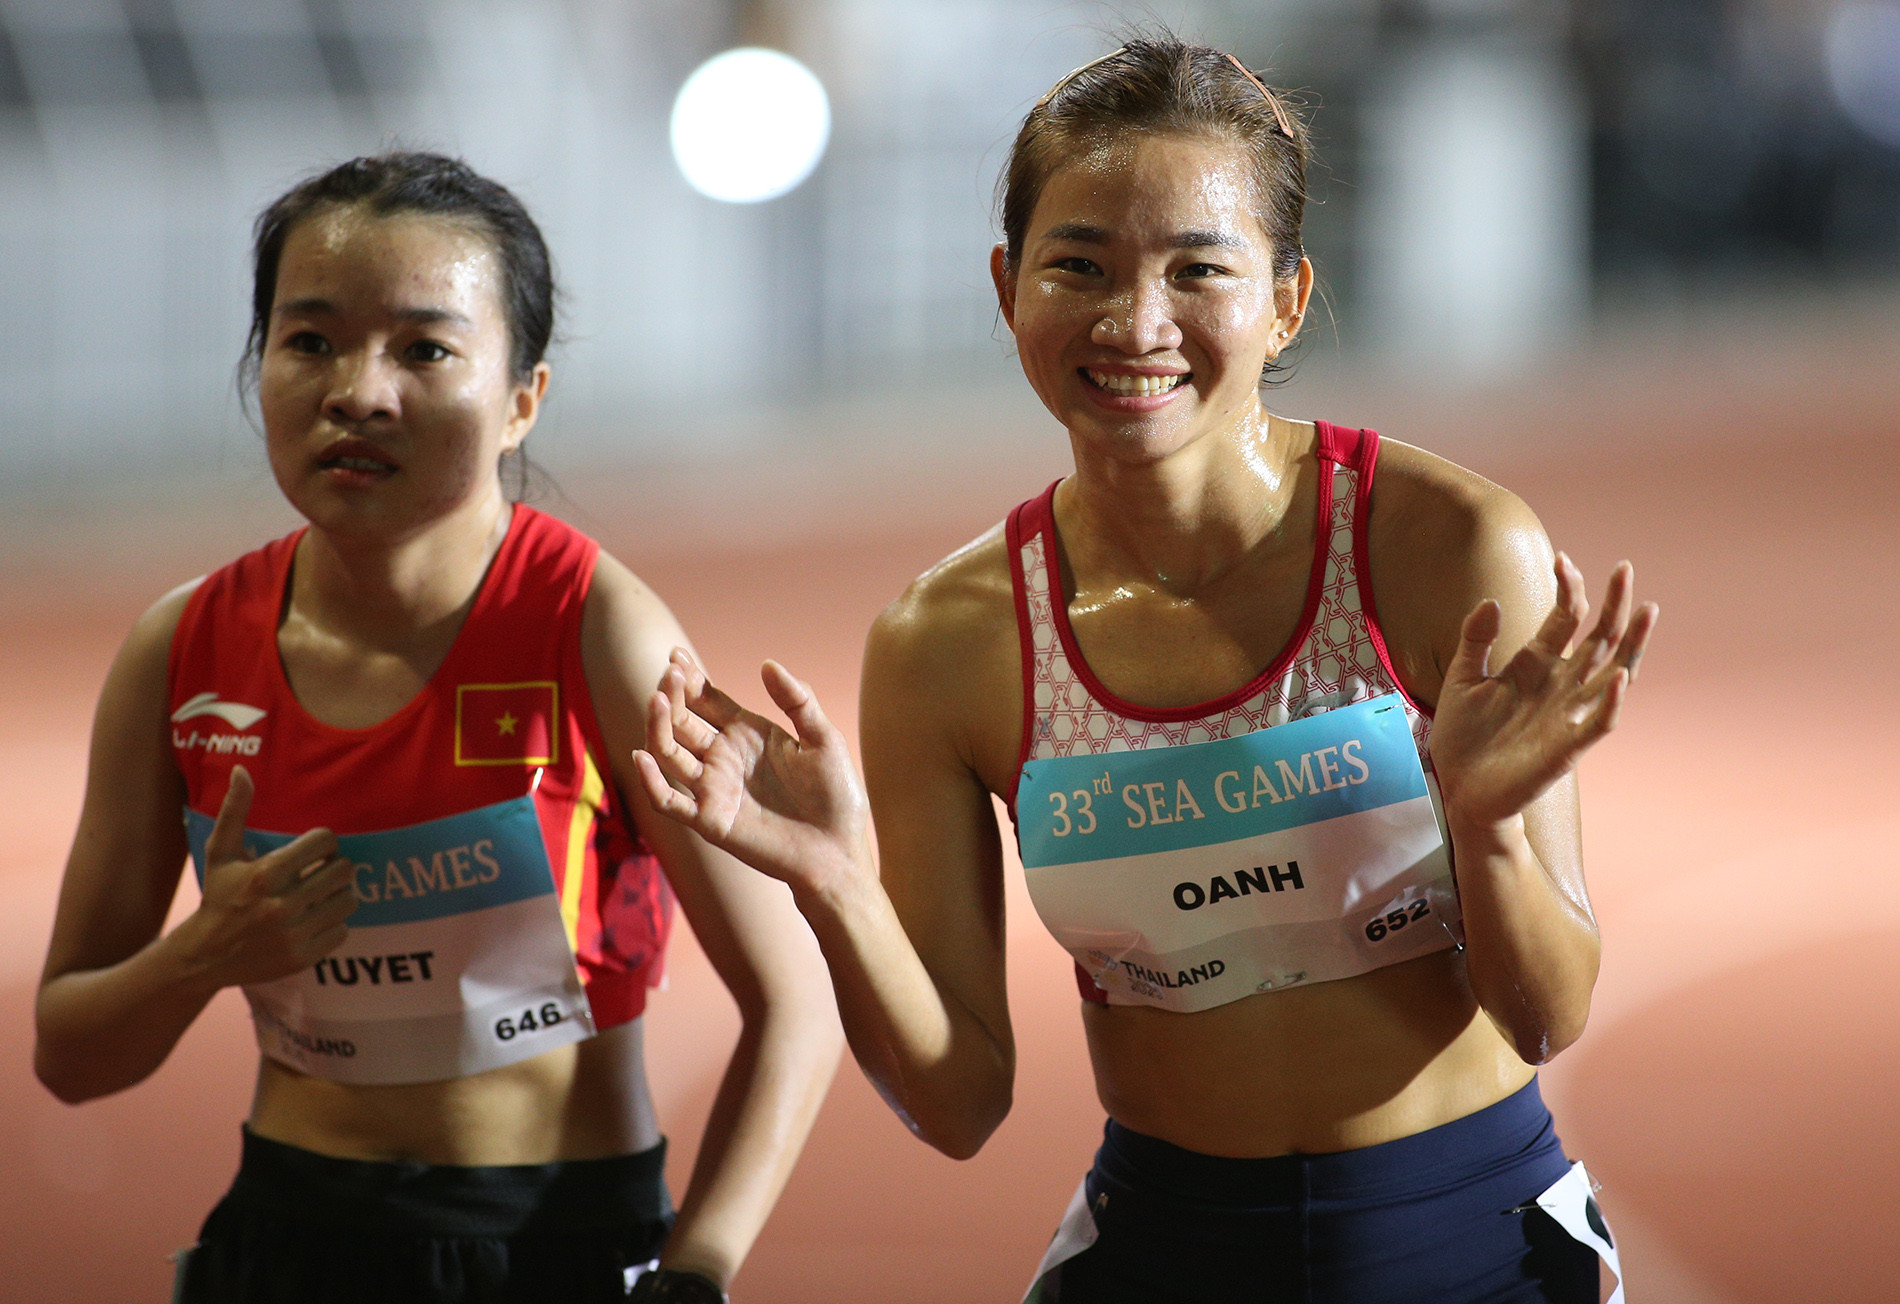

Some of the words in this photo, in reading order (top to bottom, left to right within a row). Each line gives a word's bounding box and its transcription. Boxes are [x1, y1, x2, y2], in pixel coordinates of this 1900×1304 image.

[173, 728, 263, 757] LI-NING
[1049, 771, 1113, 838] 33rd
[1121, 778, 1206, 829] SEA
[1214, 739, 1371, 814] GAMES
[352, 839, 501, 903] GAMES
[1172, 860, 1305, 912] OANH
[1365, 898, 1431, 942] 652
[315, 951, 434, 986] TUYET
[1120, 959, 1226, 989] THAILAND
[495, 1002, 562, 1042] 646
